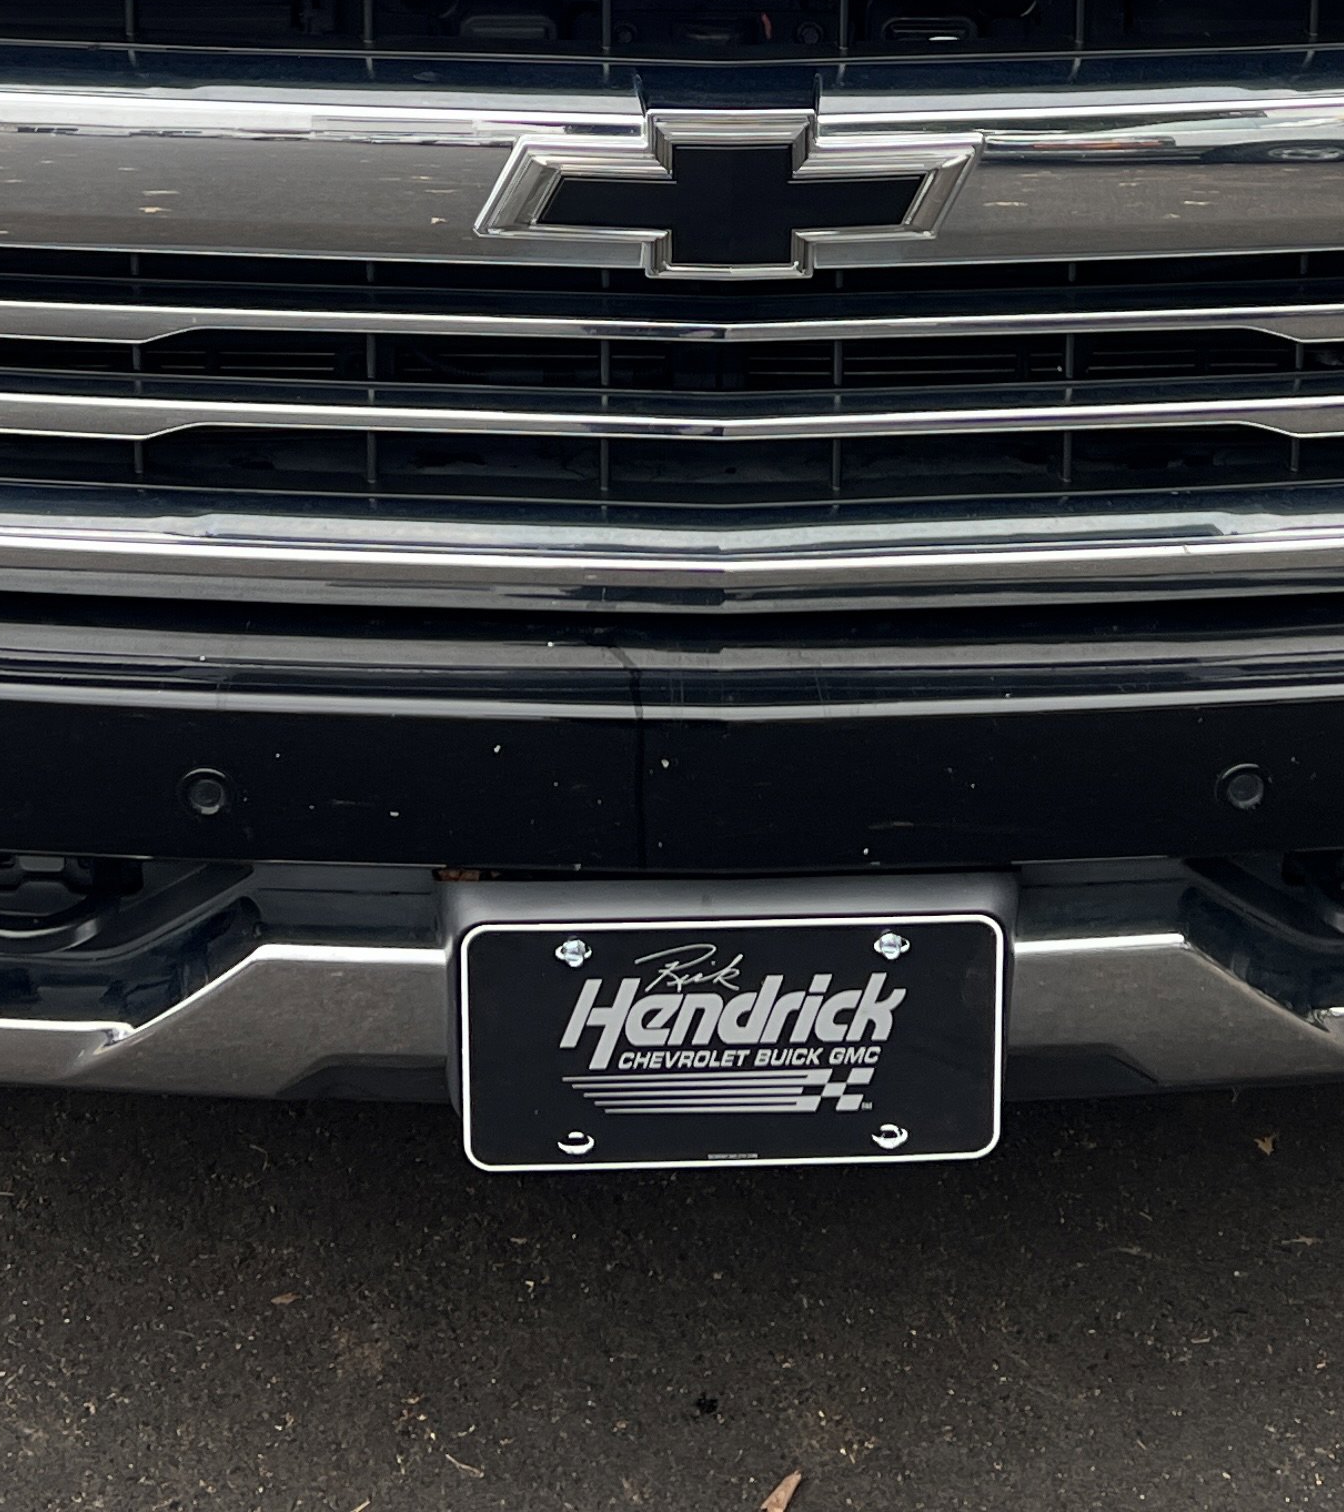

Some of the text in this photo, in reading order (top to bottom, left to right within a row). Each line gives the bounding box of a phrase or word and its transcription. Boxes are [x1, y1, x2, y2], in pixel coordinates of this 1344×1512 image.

[634, 943, 744, 993] Rick
[559, 972, 907, 1070] Hendrick
[617, 1045, 882, 1070] CHEVROLET BUICK GMC
